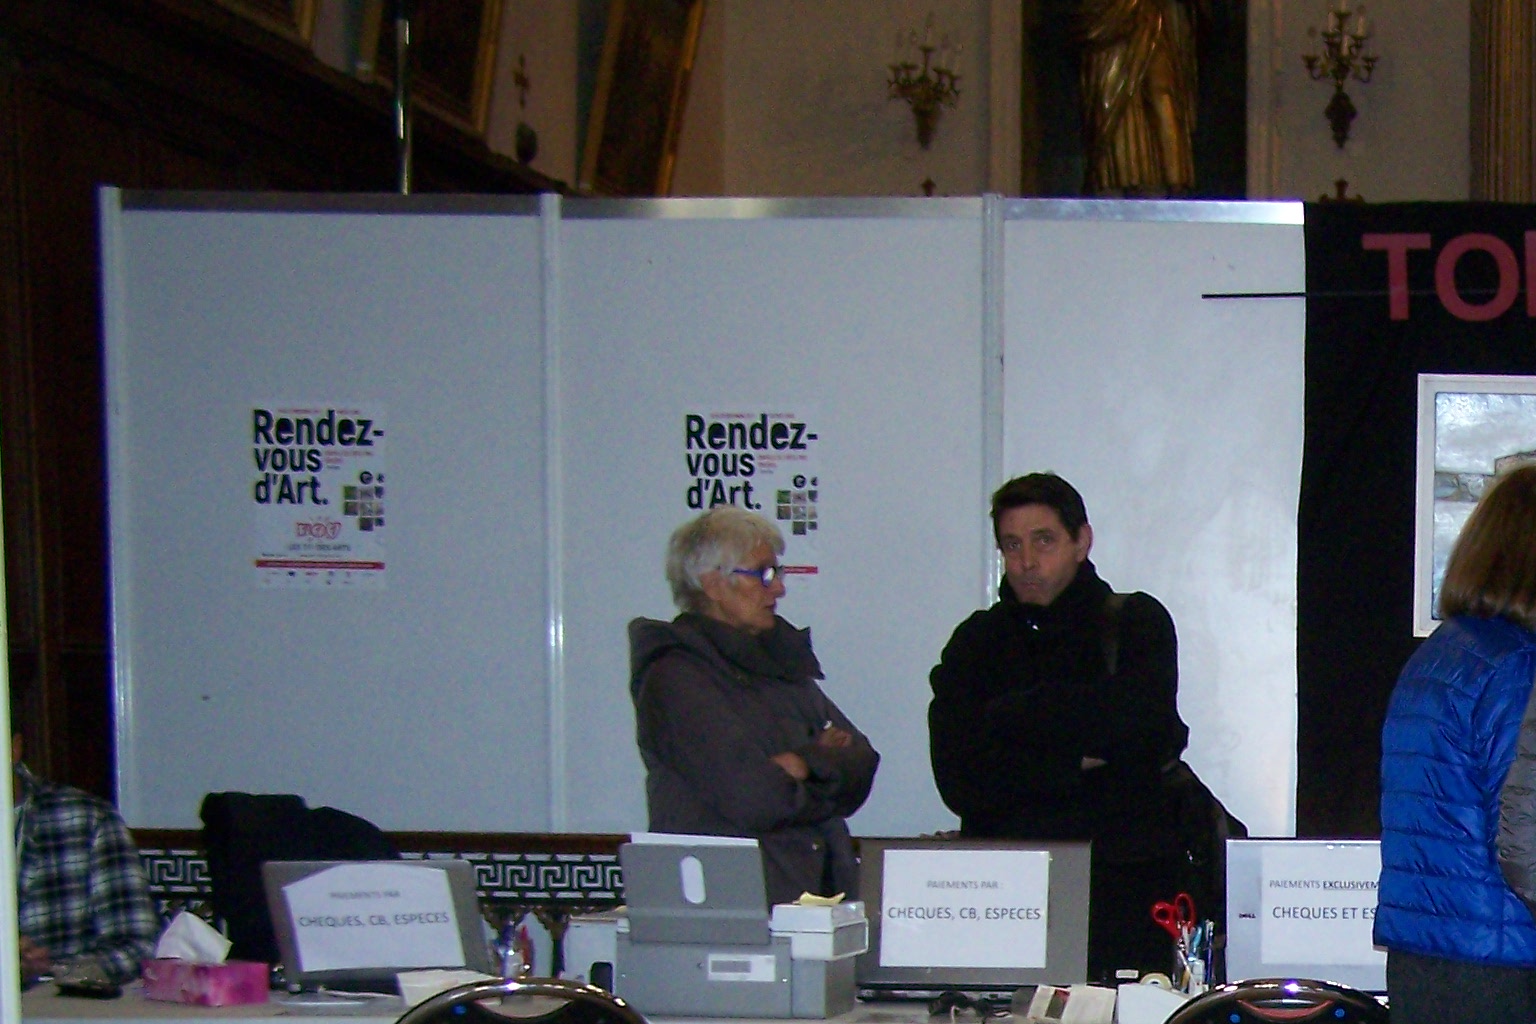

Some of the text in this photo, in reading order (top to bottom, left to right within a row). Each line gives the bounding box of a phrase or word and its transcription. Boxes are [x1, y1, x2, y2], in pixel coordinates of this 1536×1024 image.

[253, 409, 385, 446] Rendez-
[686, 413, 819, 450] Rendez-
[253, 447, 323, 473] vous
[686, 453, 756, 477] vous
[254, 472, 329, 505] d'Art.
[687, 478, 762, 509] d'Art.
[927, 880, 979, 890] PAIEMENTS
[981, 881, 999, 890] PAR
[1269, 880, 1379, 890] PAIEMENTS EXCLUSIVEM
[394, 911, 450, 926] ESPECES
[888, 906, 1042, 921] CHEQUES, CB, ESPECES
[1272, 906, 1377, 920] CHEQUES ET ES
